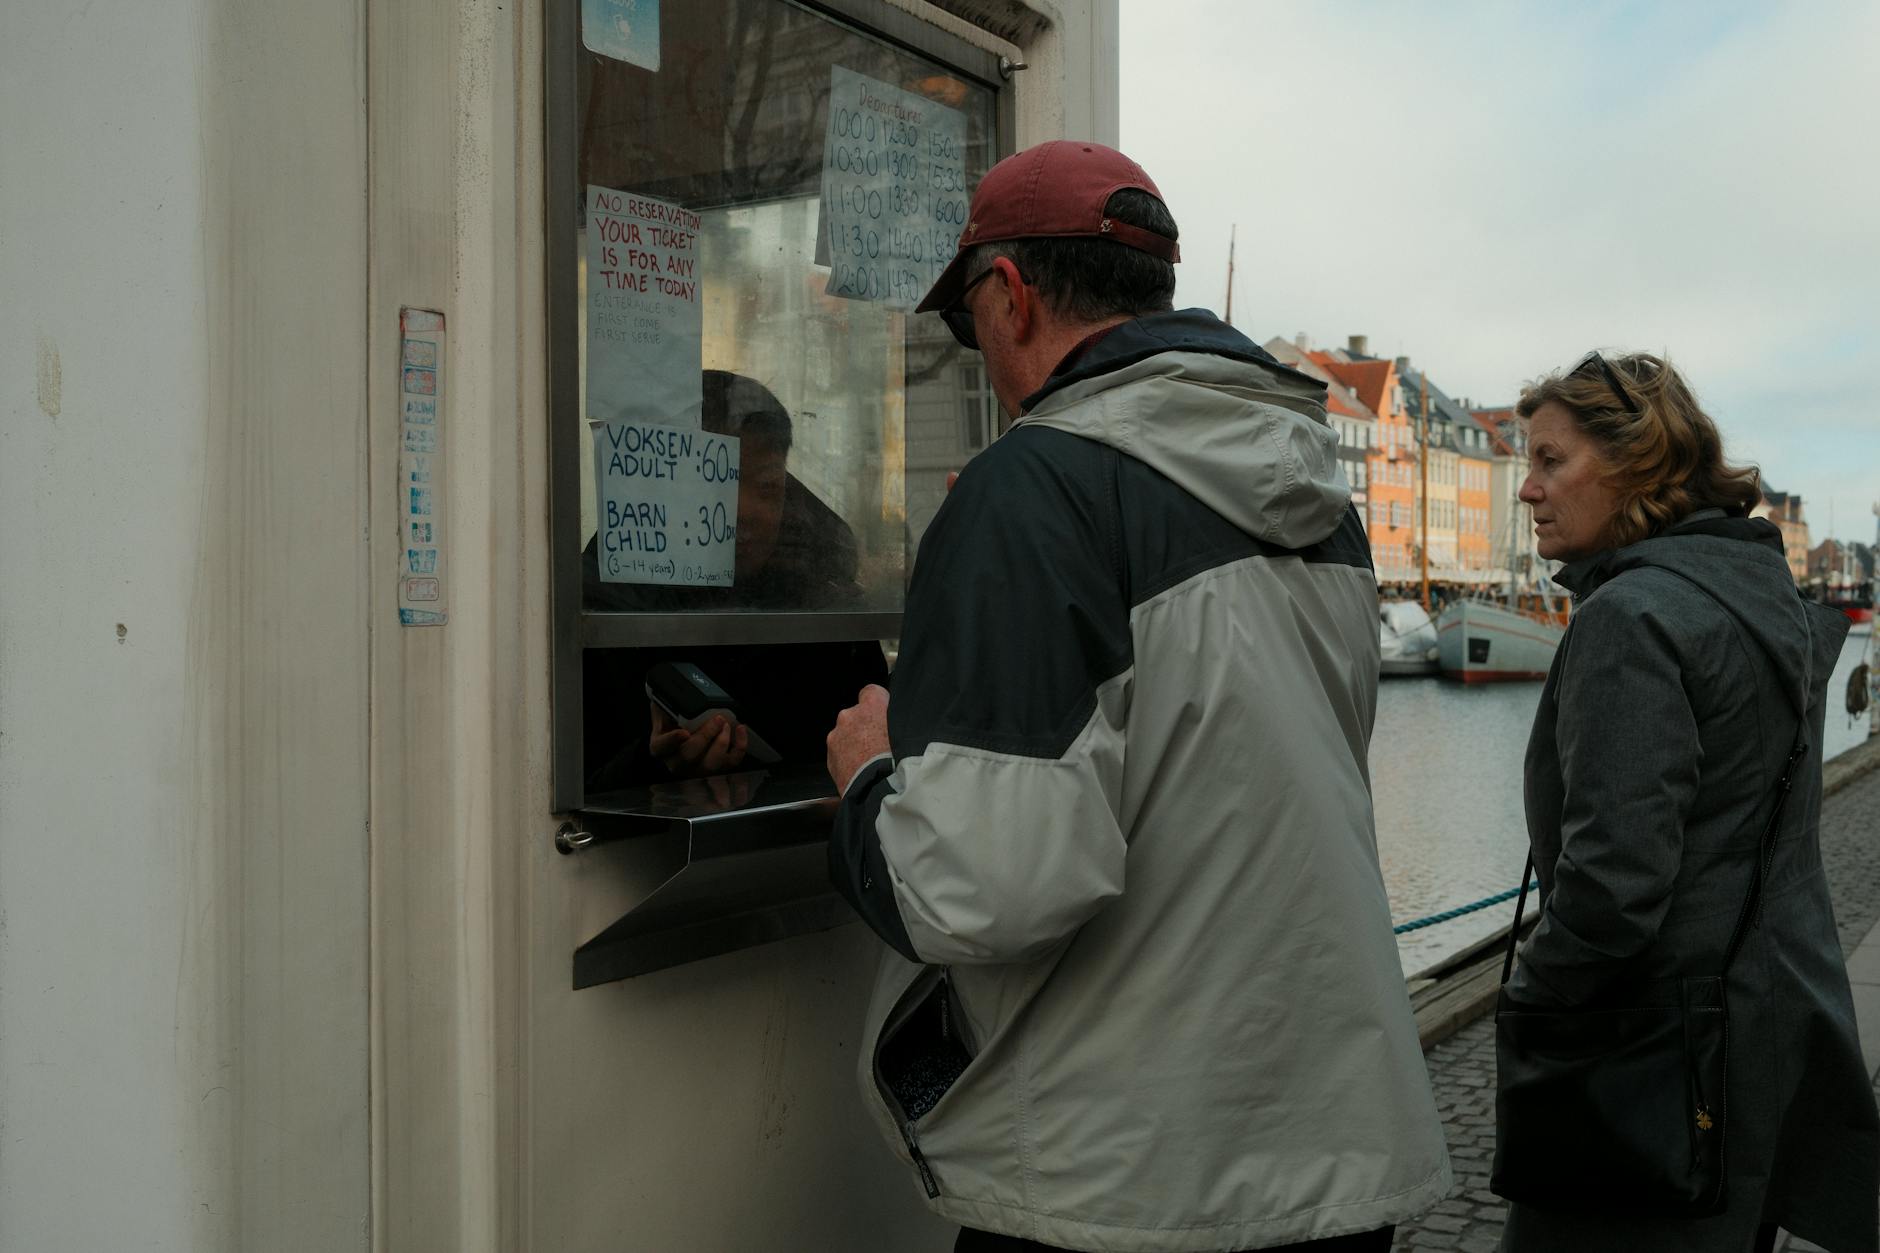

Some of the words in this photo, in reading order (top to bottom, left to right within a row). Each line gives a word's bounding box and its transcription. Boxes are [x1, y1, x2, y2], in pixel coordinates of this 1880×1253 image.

[859, 83, 923, 125] Departures
[833, 107, 876, 143] 10:00
[829, 144, 878, 177] 10:30
[595, 193, 622, 212] NO
[629, 199, 701, 231] RESERVATION
[829, 183, 882, 219] 11:00
[595, 217, 642, 245] YOUR
[647, 227, 695, 250] TICKET
[830, 222, 880, 259] 11:30
[602, 246, 618, 267] IS
[628, 249, 661, 273] FOR
[667, 255, 695, 279] ANY
[600, 270, 648, 293] TIME
[655, 277, 696, 303] TODAY
[831, 263, 879, 299] 12:00
[607, 424, 692, 458] VOKSEN
[608, 452, 677, 480] ADULT
[607, 500, 666, 529] BARN
[605, 530, 667, 553] CHILD
